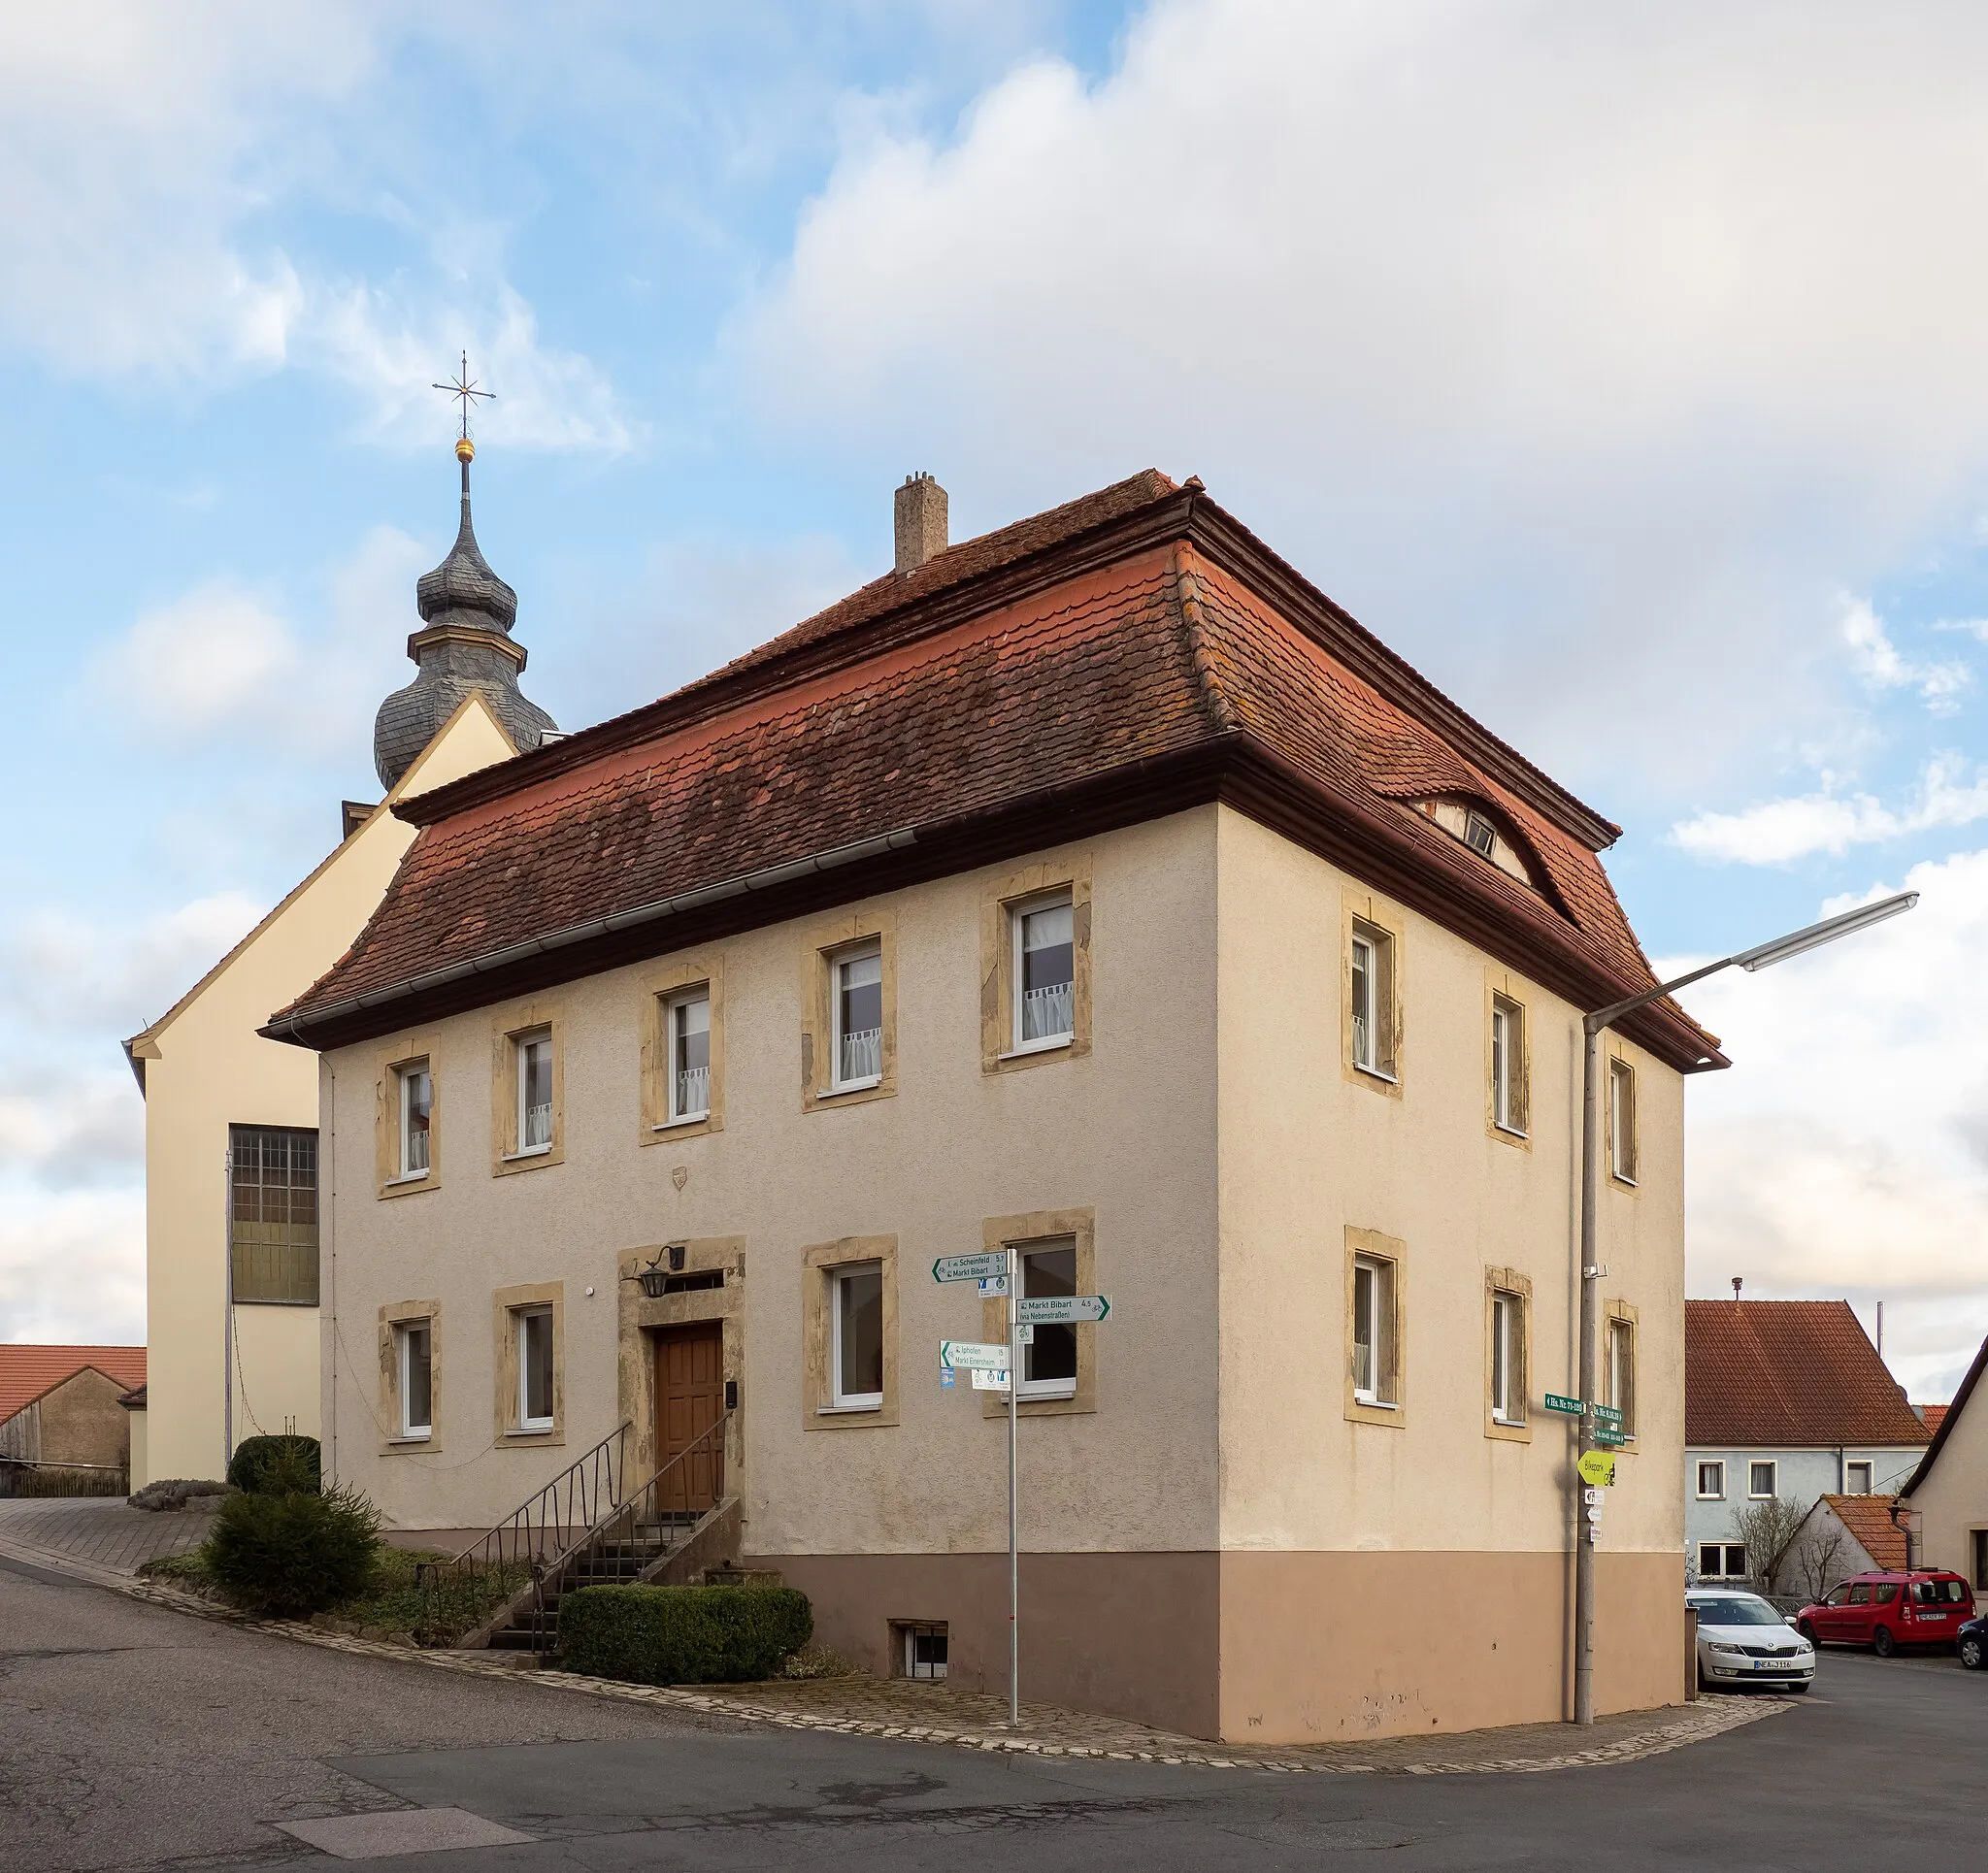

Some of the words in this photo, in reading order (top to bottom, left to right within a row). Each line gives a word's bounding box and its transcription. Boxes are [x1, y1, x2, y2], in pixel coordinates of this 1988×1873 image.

[959, 1256, 990, 1266] Scheinfeld
[952, 1269, 970, 1278] Markt
[971, 1266, 988, 1275] Bibart
[1029, 1301, 1049, 1310] Markt
[1030, 1311, 1070, 1320] Nebenstraßen)
[961, 1346, 981, 1355] Iphofen
[969, 1357, 995, 1366] Einersheim
